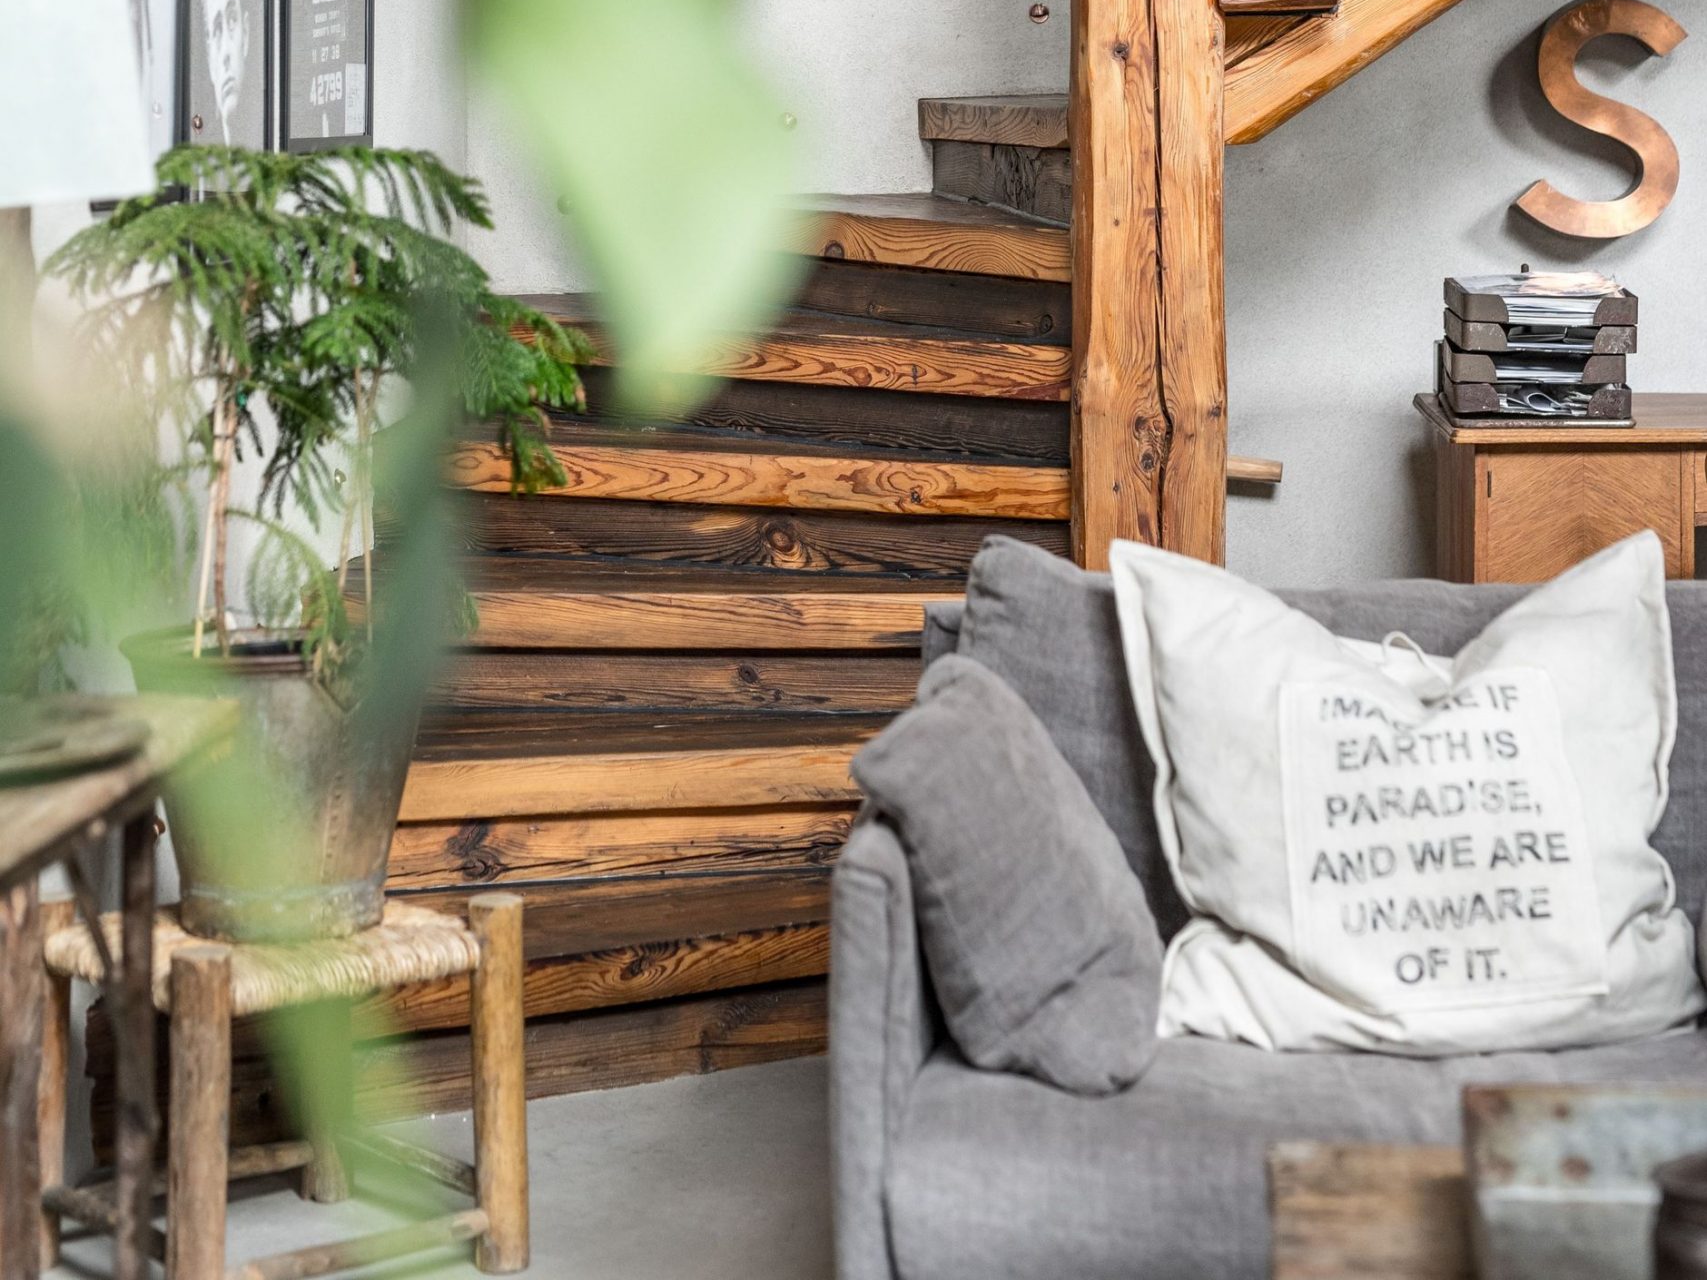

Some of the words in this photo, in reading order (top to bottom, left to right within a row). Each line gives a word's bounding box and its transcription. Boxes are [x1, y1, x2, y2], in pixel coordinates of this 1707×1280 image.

[310, 71, 343, 106] 42799
[1319, 687, 1478, 730] IMAE
[1486, 685, 1520, 712] IF
[1336, 730, 1473, 772] EARTH
[1482, 728, 1520, 762] IS
[1310, 844, 1397, 885] AND
[1407, 834, 1477, 875] WE
[1487, 830, 1571, 871] ARE
[1341, 886, 1553, 937] UNAWARE
[1394, 946, 1451, 985] OF
[1464, 946, 1508, 983] IT.
